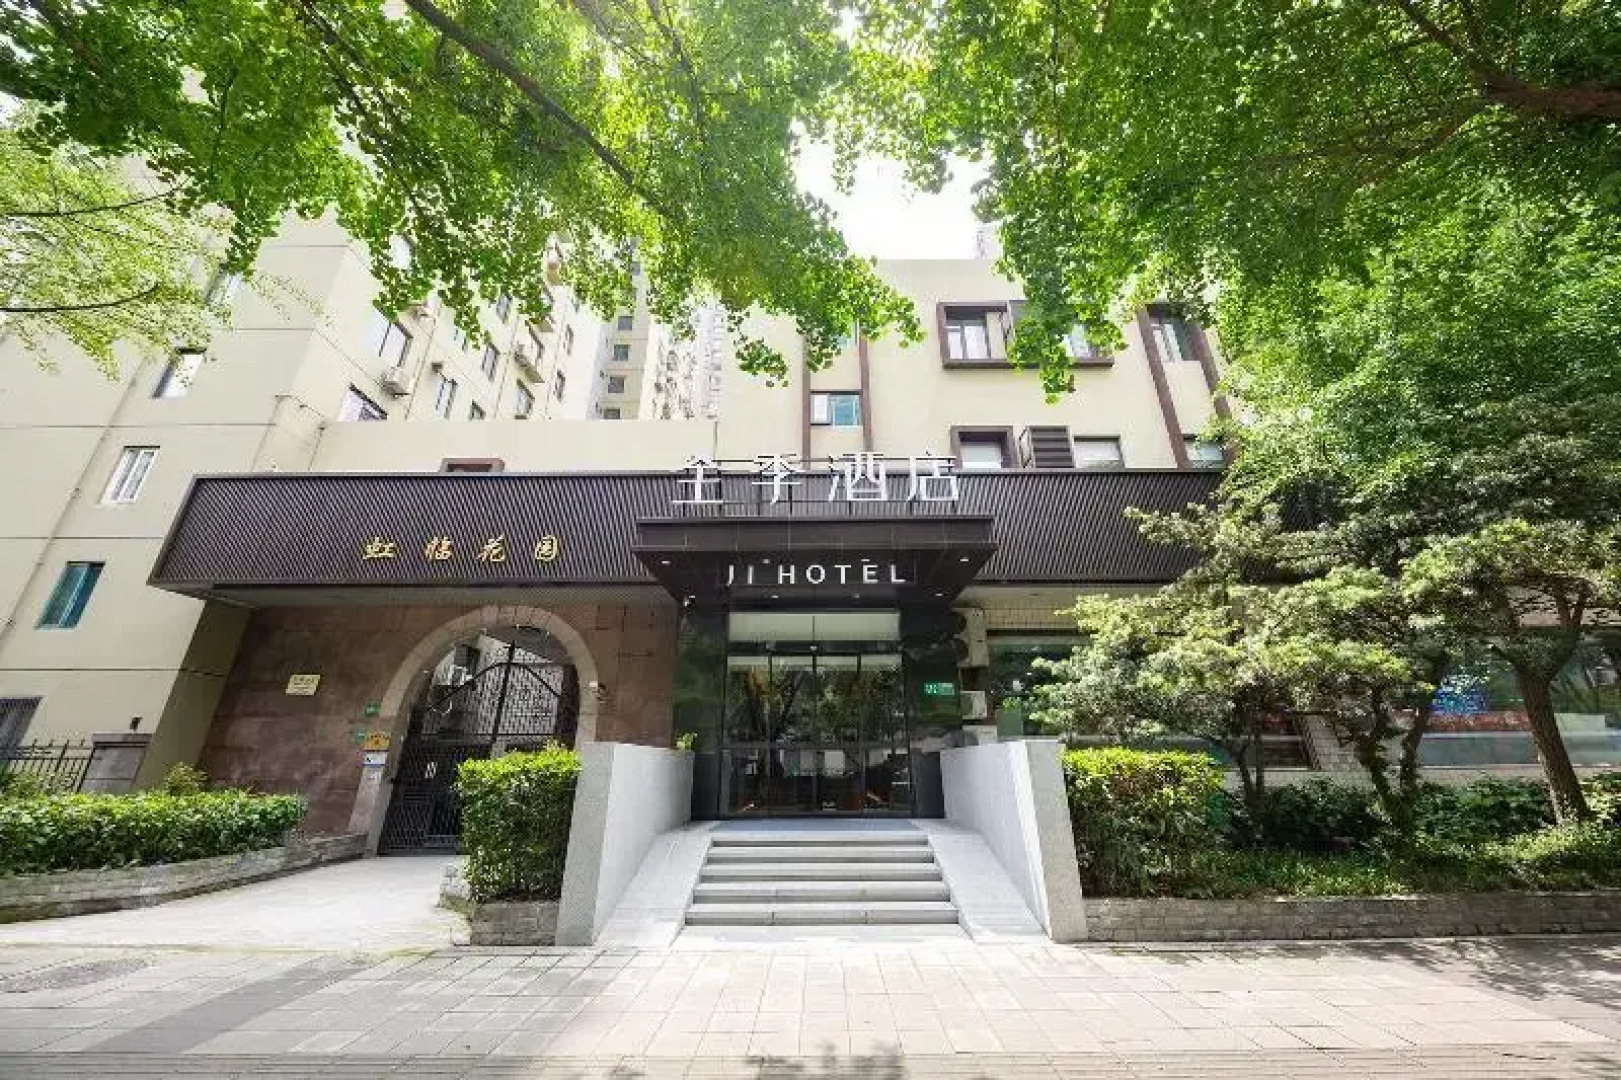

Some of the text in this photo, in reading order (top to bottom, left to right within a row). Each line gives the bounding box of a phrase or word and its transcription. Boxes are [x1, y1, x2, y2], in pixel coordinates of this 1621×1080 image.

[671, 447, 960, 505] 全季酒店
[726, 563, 907, 586] JI HOTEL
